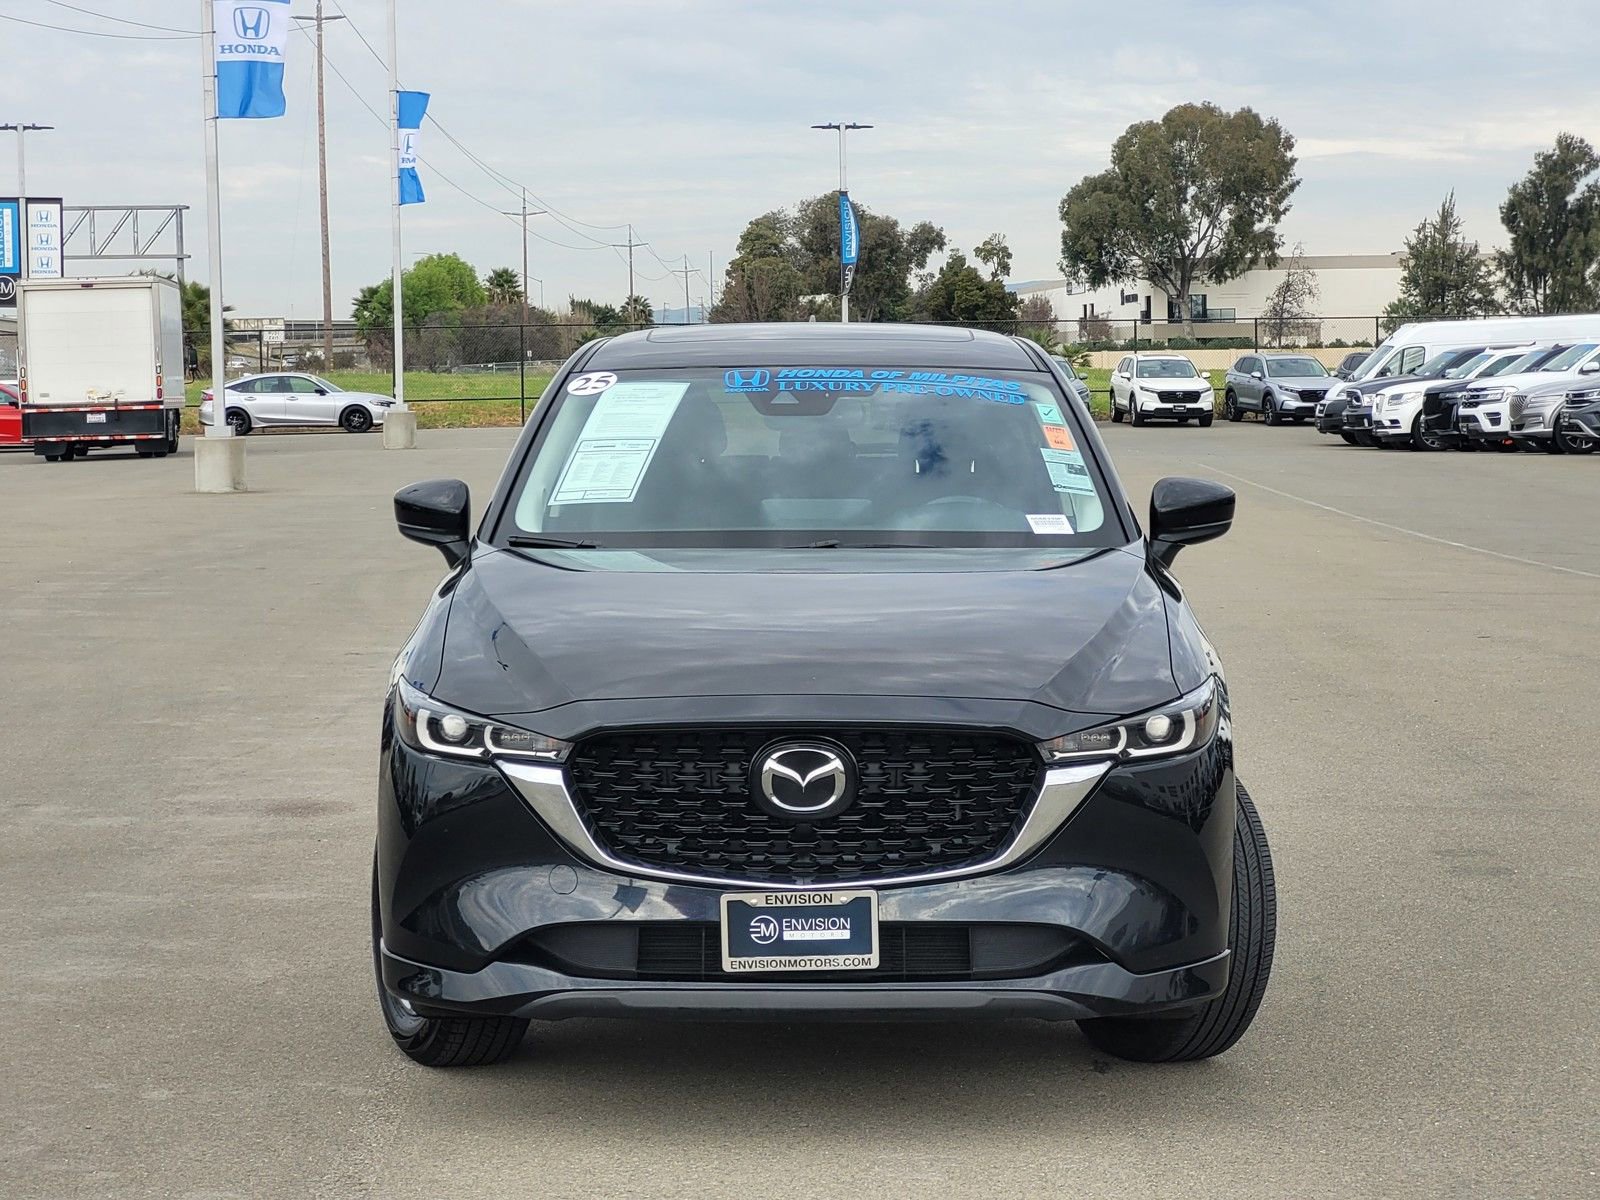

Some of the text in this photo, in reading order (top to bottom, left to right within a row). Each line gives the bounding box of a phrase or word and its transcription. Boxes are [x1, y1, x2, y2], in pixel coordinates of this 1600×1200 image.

[218, 44, 282, 56] HONDA
[571, 374, 612, 391] 25
[777, 369, 1021, 391] HONDA OF MILPITAS
[779, 381, 1025, 405] LUXURY PRE-OWNED
[765, 893, 833, 905] ENVISION
[782, 917, 851, 931] ENVISION
[730, 957, 872, 970] ENVISIONMOTORS.COM
